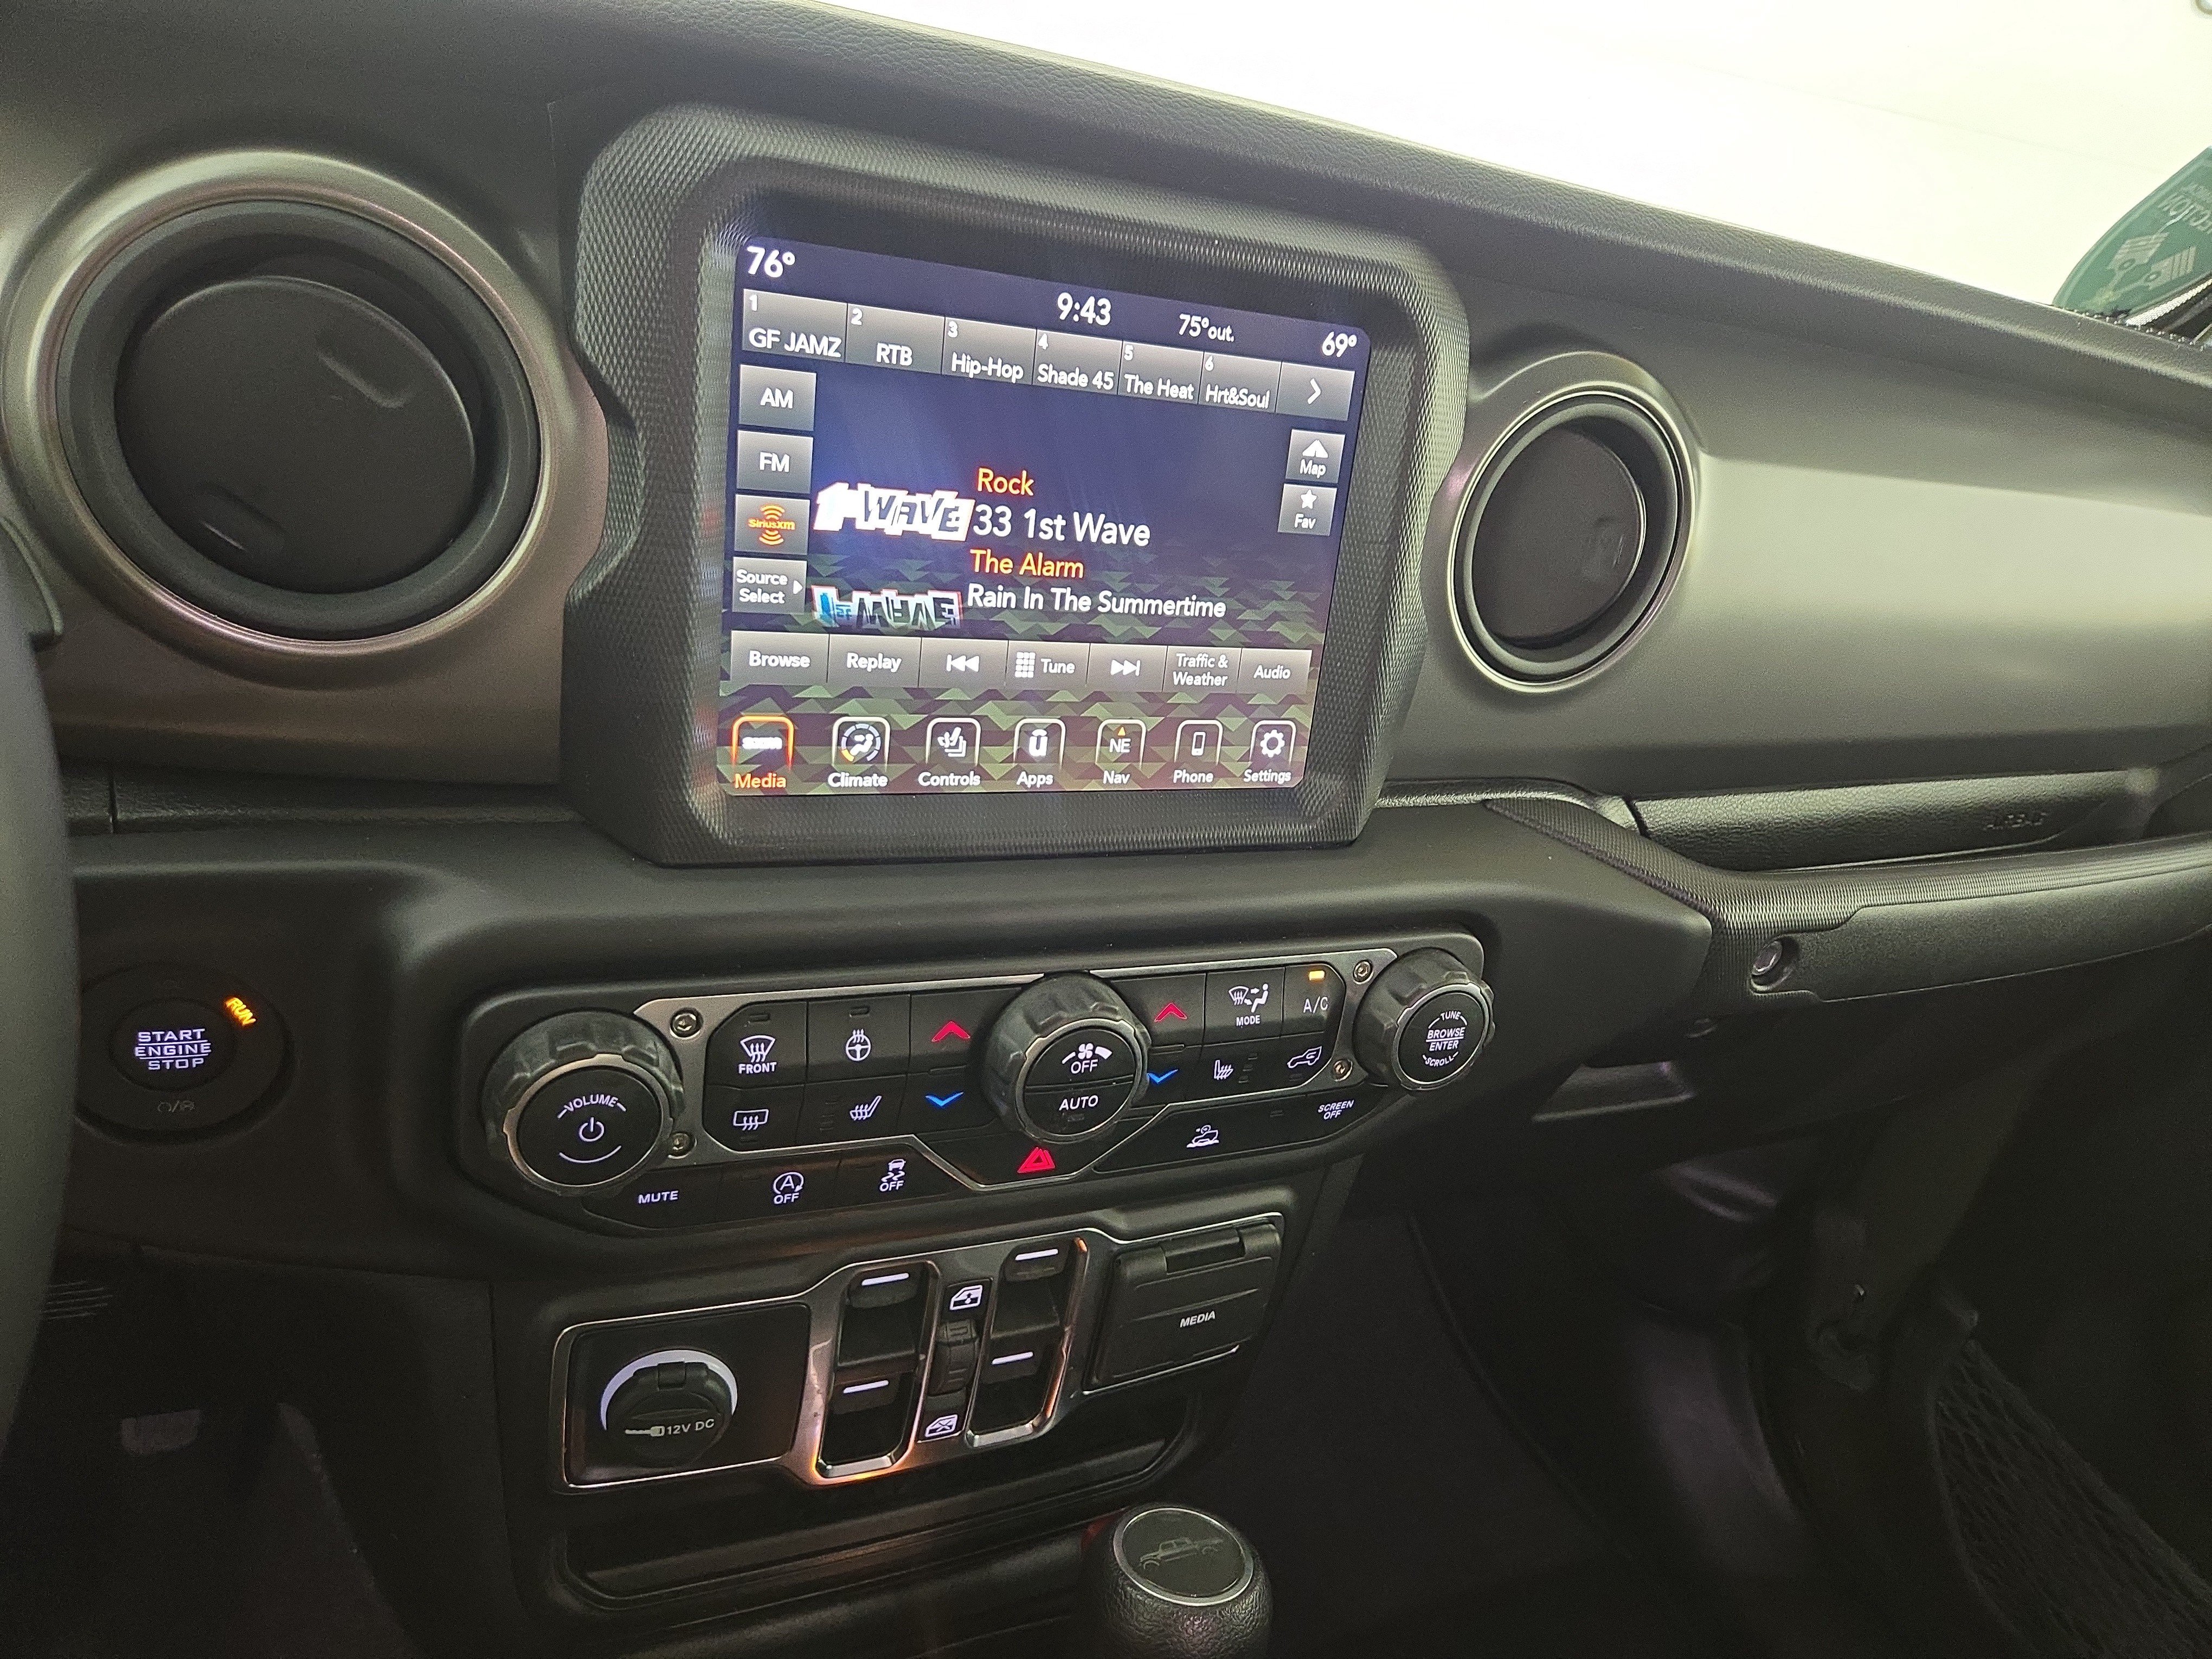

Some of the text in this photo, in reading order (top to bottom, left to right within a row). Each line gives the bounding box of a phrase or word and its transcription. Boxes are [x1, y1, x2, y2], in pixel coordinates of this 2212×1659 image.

[749, 294, 758, 311] 1
[1057, 292, 1111, 325] 9:43
[851, 308, 863, 325] 2
[948, 321, 958, 338] 3
[749, 329, 842, 358] GF JAMZ
[1038, 334, 1049, 350] 4
[876, 343, 913, 366] RTB
[1124, 345, 1134, 361] 5
[951, 352, 1024, 383] Hip-Hop
[1205, 356, 1214, 371] 6
[1037, 363, 1114, 390] Shade 45
[1124, 374, 1195, 401] The Heat
[760, 387, 794, 409] AM
[1205, 387, 1271, 409] Hrt&Soul
[759, 452, 790, 473] FM
[1300, 459, 1326, 478] Map
[978, 467, 1034, 497] Rock
[973, 504, 1150, 547] 33 1st Wave
[1294, 514, 1316, 530] Fav
[970, 549, 1084, 579] The Alarm
[736, 569, 788, 586] Source
[739, 588, 785, 606] Select
[967, 583, 1226, 618] Rain In The Summertime
[749, 651, 811, 669] Browse
[846, 653, 902, 674] Replay
[1040, 658, 1076, 674] Tune
[1176, 653, 1229, 669] Traffic &
[1172, 670, 1229, 687] Weather
[1253, 665, 1291, 680] Audio
[1109, 738, 1131, 754] NE
[735, 773, 787, 789] Media
[828, 771, 888, 788] Climate
[918, 771, 981, 787] Controls
[1017, 770, 1054, 789] Apps
[1103, 770, 1131, 785] Nav
[1173, 769, 1214, 784] Phone
[1243, 769, 1292, 785] Settings
[224, 996, 256, 1026] RUN
[1303, 996, 1328, 1014] A/C
[1236, 1015, 1261, 1027] MODE
[1440, 1011, 1462, 1021] TUNE
[138, 1028, 205, 1043] START
[1426, 1026, 1466, 1039] BROWSE
[134, 1043, 212, 1057] ENGINE
[1429, 1040, 1460, 1052] ENTER
[148, 1058, 205, 1071] STOP
[738, 1062, 777, 1075] FRONT
[1070, 1058, 1099, 1075] OFF
[1425, 1056, 1454, 1066] SCROLL
[564, 1094, 619, 1113] VOLUME
[1059, 1095, 1099, 1111] AUTO
[1317, 1099, 1354, 1114] SCREEN
[1323, 1109, 1342, 1120] OFF
[879, 1180, 904, 1192] OFF
[638, 1190, 679, 1205] MUTE
[773, 1193, 800, 1205] OFF
[1179, 1310, 1216, 1328] MEDIA
[666, 1418, 715, 1435] 12V DC
